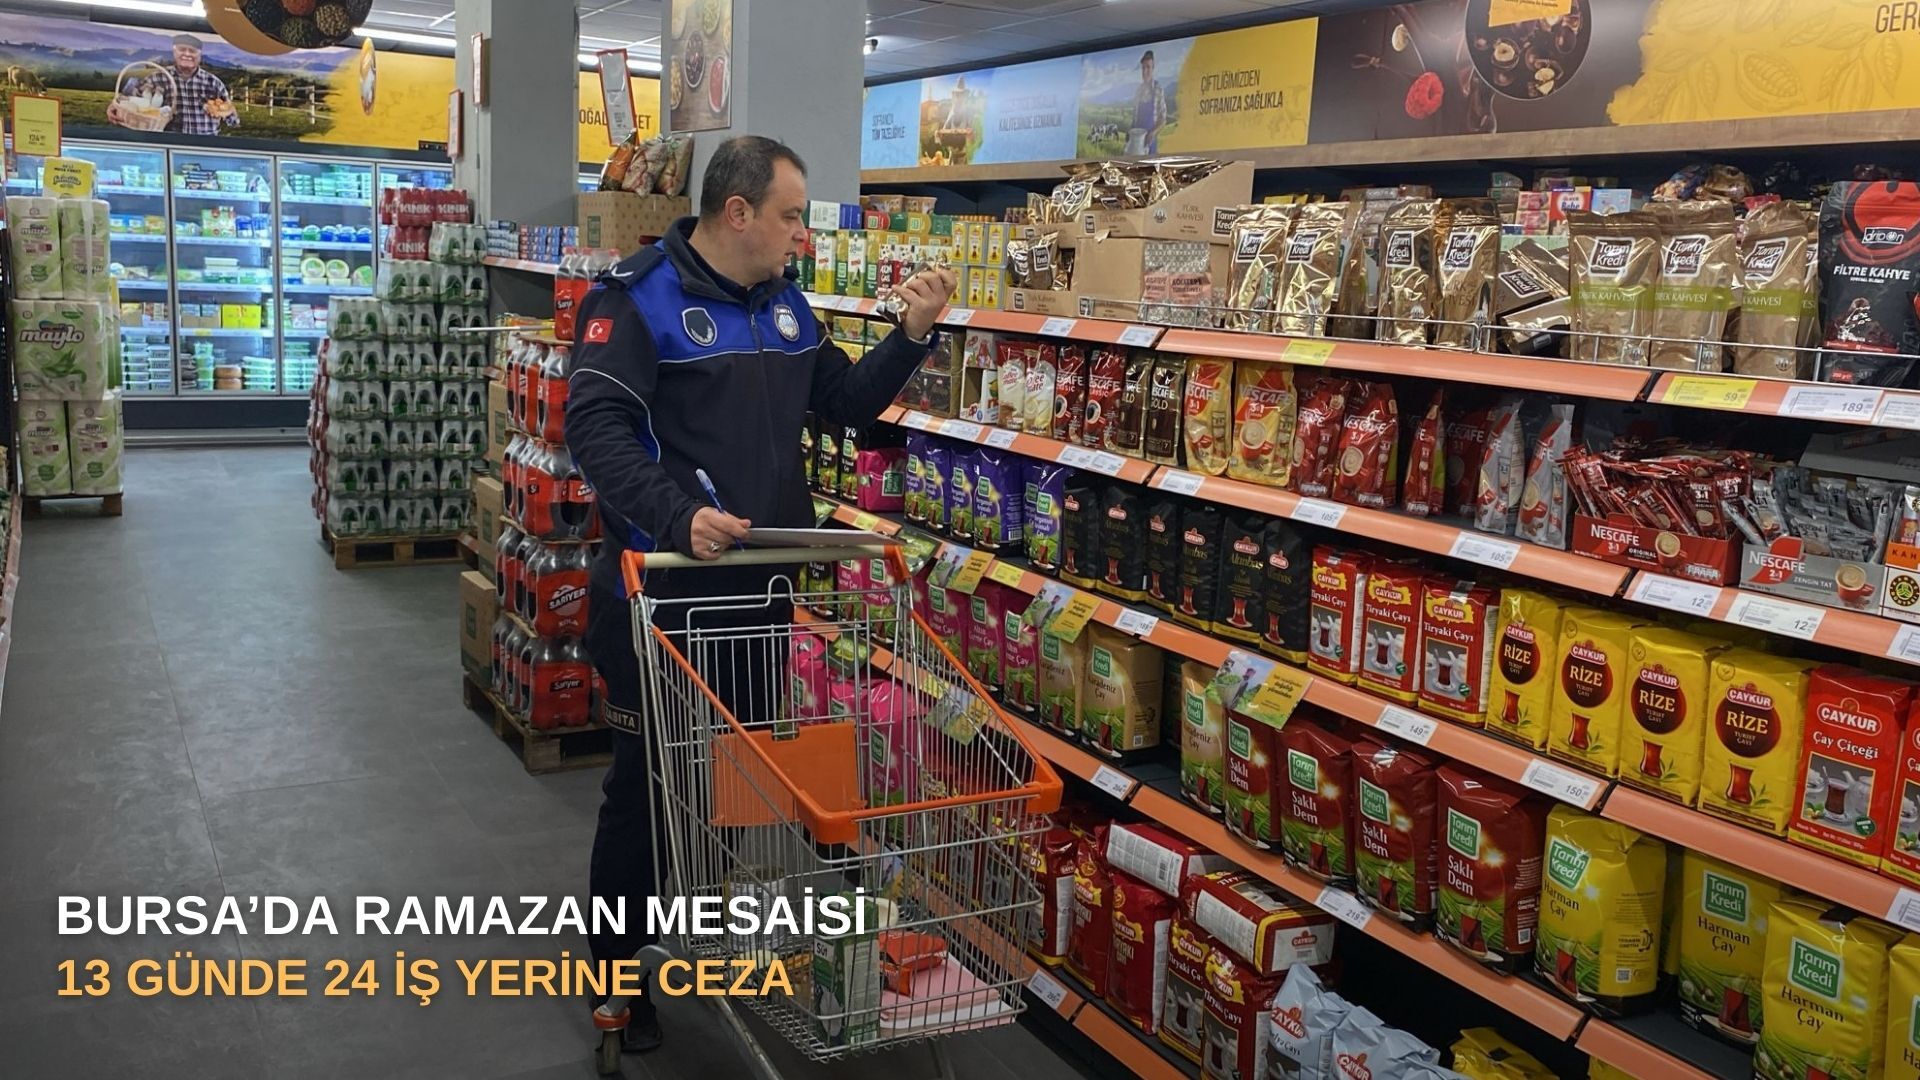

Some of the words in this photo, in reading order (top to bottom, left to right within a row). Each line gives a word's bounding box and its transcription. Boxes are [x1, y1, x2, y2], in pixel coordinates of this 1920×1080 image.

[1599, 241, 1629, 254] Tarım
[1595, 253, 1624, 266] Kredi
[1833, 264, 1867, 277] FİLTRE
[1869, 266, 1911, 280] KAHVE
[20, 323, 85, 350] maylo
[1088, 379, 1121, 390] ESCAFE
[1152, 386, 1176, 400] ESCAFE
[1186, 384, 1219, 402] ESCAFE
[1842, 402, 1863, 413] 189
[1591, 523, 1640, 547] NESCAFE
[1749, 550, 1807, 574] NESCAFE
[549, 586, 587, 609] SARIYER
[1311, 589, 1331, 604] Tiryaki
[1331, 595, 1347, 608] Çayı
[1365, 603, 1391, 619] Tiryaki
[1392, 611, 1411, 623] Çayı
[1424, 621, 1451, 637] Tiryaki
[1453, 629, 1474, 643] Çayı
[1504, 643, 1532, 666] RİZE
[1569, 664, 1603, 688] RİZE
[1639, 688, 1675, 712] RİZE
[1410, 724, 1424, 736] 149
[1726, 709, 1769, 735] RİZE
[1820, 706, 1878, 732] ÇAYKUR
[1812, 731, 1834, 749] Çay
[1836, 738, 1879, 759] Çiçeği
[1230, 757, 1249, 778] Saklı
[1230, 772, 1249, 792] Dem
[1565, 784, 1583, 797] 150
[1292, 790, 1317, 811] Saklı
[1293, 804, 1318, 826] Dem
[1451, 814, 1477, 837] Tarım
[1362, 820, 1388, 844] Saklı
[1452, 827, 1473, 848] Kredi
[1363, 834, 1389, 858] Dem
[1552, 841, 1587, 869] Tarım
[1448, 854, 1474, 881] Saklı
[1550, 857, 1580, 881] Kredi
[1448, 869, 1474, 896] Dem
[1708, 876, 1746, 900] Tarım
[1544, 880, 1580, 912] Harman
[1710, 890, 1743, 914] Kredi
[1550, 900, 1568, 919] Çay
[1697, 915, 1751, 946] Harman
[1711, 935, 1736, 957] Çay
[1797, 946, 1838, 974] Tarım
[1797, 961, 1834, 989] Kredi
[1781, 985, 1845, 1023] Harman
[1223, 1008, 1243, 1025] Çayı
[1796, 1009, 1825, 1034] Çay
